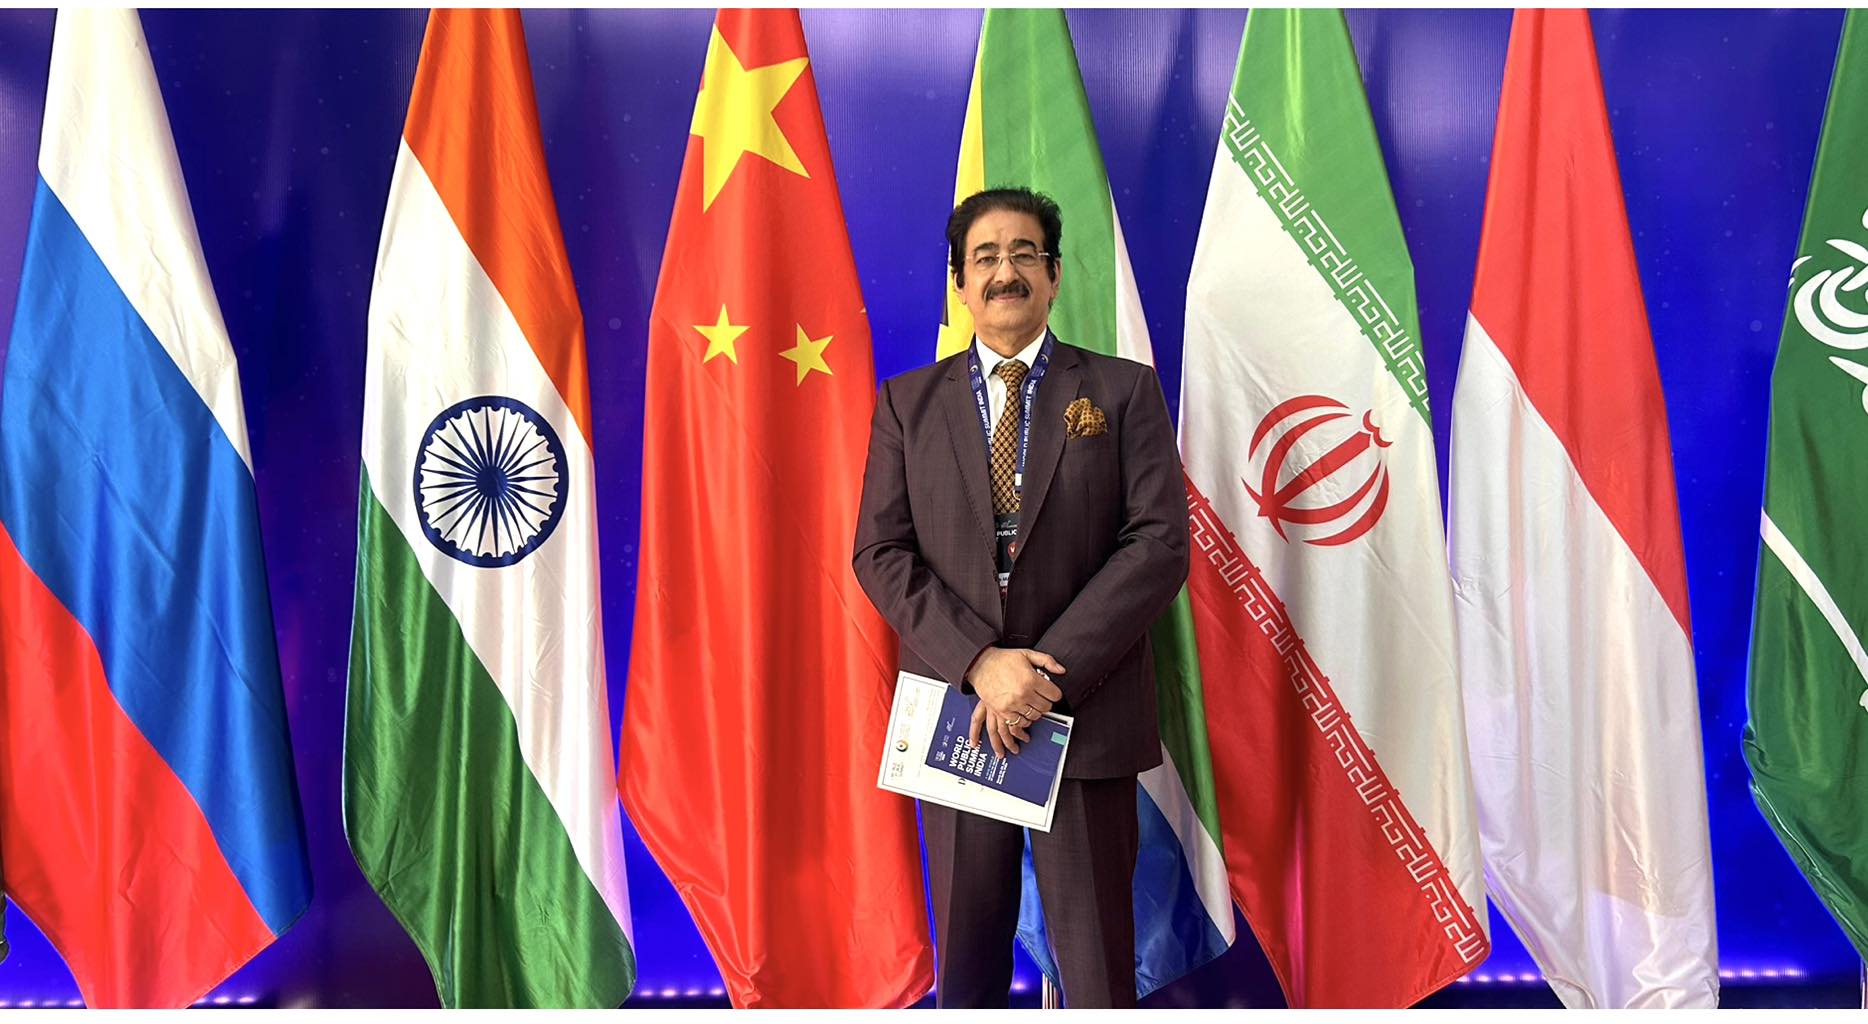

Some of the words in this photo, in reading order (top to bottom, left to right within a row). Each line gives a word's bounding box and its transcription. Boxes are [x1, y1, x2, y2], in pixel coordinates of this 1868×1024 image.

[980, 405, 990, 428] SUMMIT
[949, 736, 965, 767] WORLD
[974, 754, 988, 777] INDIA
